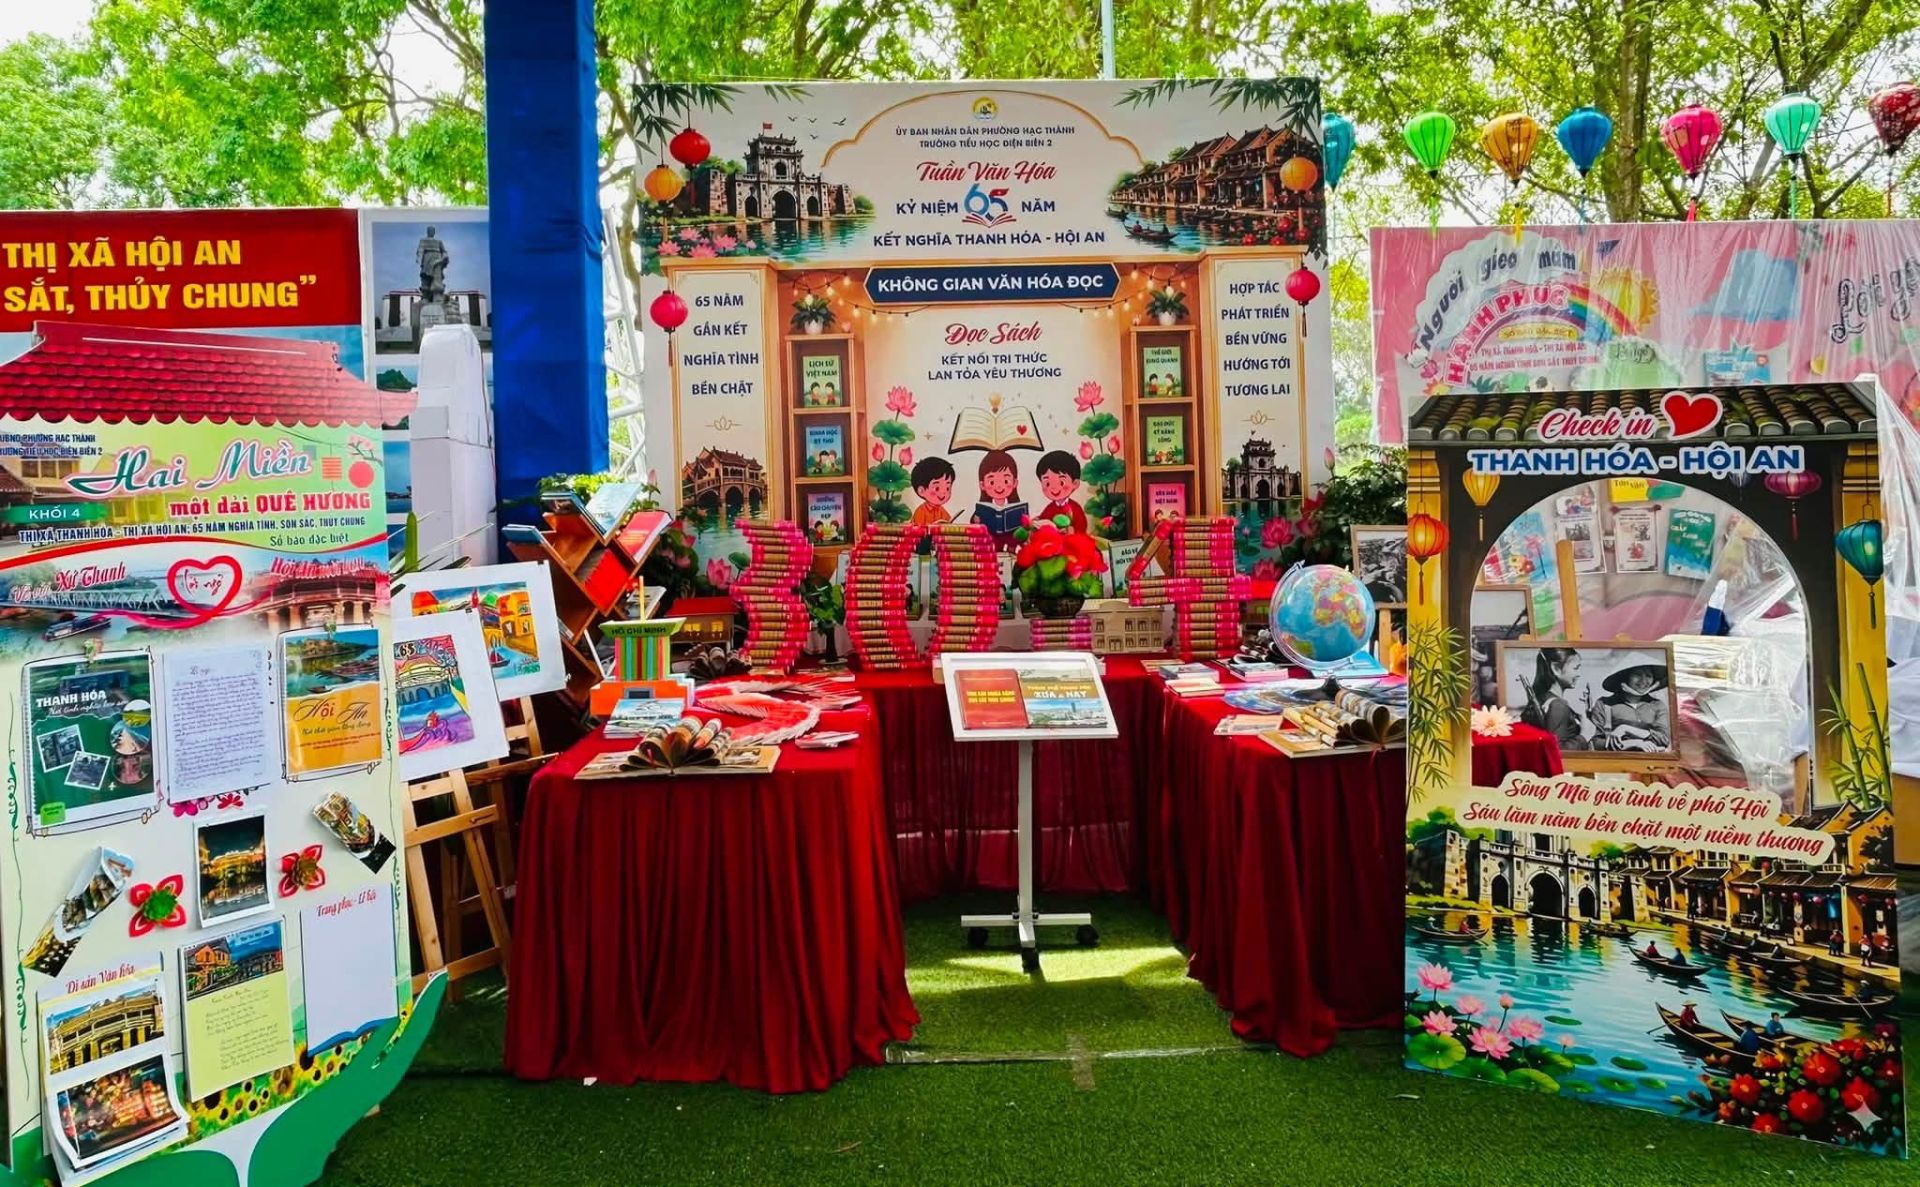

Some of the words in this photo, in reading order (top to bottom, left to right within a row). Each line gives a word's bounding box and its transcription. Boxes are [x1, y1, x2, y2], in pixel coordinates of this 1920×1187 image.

[895, 124, 909, 136] ỦY
[910, 126, 929, 136] BAN
[931, 125, 958, 136] NHÂN
[959, 125, 980, 136] DÂN
[982, 124, 1020, 135] PHƯỜNG
[1022, 126, 1043, 137] HẠC
[1045, 125, 1075, 135] THÀNH
[919, 138, 957, 149] TRƯỜNG
[958, 137, 978, 148] TIỂU
[979, 139, 999, 149] HỌC
[1046, 138, 1053, 148] 2
[916, 159, 967, 182] Tuần
[967, 161, 1011, 182] Văn
[1013, 160, 1058, 184] Hóa
[896, 197, 917, 215] KỶ
[921, 198, 959, 216] NIỆM
[963, 183, 1010, 221] 65
[1021, 197, 1056, 213] NĂM
[873, 230, 901, 247] KẾT
[905, 232, 952, 246] NGHĨA
[955, 234, 1007, 246] THANH
[1010, 231, 1042, 245] HÓA
[1055, 229, 1080, 245] HỘI
[1084, 231, 1106, 243] AN
[2, 242, 57, 274] THỊ
[68, 235, 116, 268] XÃ
[125, 235, 183, 272] HỘI
[193, 239, 242, 266] AN
[878, 274, 939, 293] KHÔNG
[942, 277, 984, 291] GIAN
[987, 275, 1022, 290] VĂN
[1026, 273, 1064, 290] HÓA
[1067, 275, 1104, 292] ĐỌC
[1228, 282, 1254, 298] HỢP
[1256, 280, 1280, 295] TÁC
[3, 276, 75, 315] SẮT,
[84, 275, 172, 311] THỦY
[694, 295, 711, 307] 65
[713, 294, 744, 307] NĂM
[1221, 306, 1254, 320] PHÁT
[1254, 303, 1290, 319] TRIỂN
[692, 323, 721, 337] GẮN
[723, 322, 748, 336] KẾT
[944, 322, 989, 347] Đọc
[990, 320, 1043, 346] Sách
[1252, 330, 1288, 345] VỮNG
[683, 352, 726, 366] NGHĨA
[727, 351, 760, 365] TÌNH
[941, 352, 965, 366] KẾT
[968, 352, 990, 365] NỐI
[992, 354, 1012, 365] TRI
[1014, 350, 1048, 364] THỨC
[1223, 357, 1270, 372] HƯỚNG
[1271, 356, 1291, 370] TỚI
[928, 370, 952, 381] LAN
[955, 367, 981, 380] TỎA
[983, 366, 1007, 380] YÊU
[1010, 366, 1062, 379] THƯƠNG
[720, 380, 754, 397] CHẶT
[1225, 383, 1270, 397] TƯƠNG
[1271, 383, 1291, 395] LAI
[1540, 410, 1621, 440] Check
[1622, 411, 1656, 437] in
[67, 447, 186, 494] Hai
[196, 437, 312, 489] Miền
[1471, 450, 1577, 472] THANH
[1586, 444, 1655, 471] HÓA
[1684, 443, 1742, 477] HỘI
[1752, 448, 1801, 470] AN
[28, 506, 67, 520] KHỐI
[71, 508, 81, 518] 4
[168, 496, 210, 520] một
[217, 494, 250, 515] dải
[255, 490, 297, 513] QUÊ
[302, 492, 371, 511] HƯƠNG
[56, 528, 93, 542] THANH
[123, 526, 138, 538] THỊ
[156, 524, 171, 537] HỘI
[192, 521, 204, 533] 65
[205, 520, 226, 533] NĂM
[228, 519, 255, 532] NGHĨA
[340, 516, 366, 527] CHUNG
[81, 560, 126, 587] Thanh
[399, 641, 415, 656] 65
[35, 692, 78, 708] THANH
[81, 689, 107, 701] HÓA
[293, 697, 337, 722] Hội
[1504, 777, 1550, 800] Sông
[1555, 780, 1589, 804] Mã
[1626, 787, 1663, 809] tình
[1667, 790, 1690, 811] về
[1688, 791, 1725, 817] phố
[1724, 795, 1770, 821] Hội
[1463, 801, 1502, 822] Sáu
[1504, 805, 1537, 825] lăm
[1540, 811, 1580, 830] năm
[1584, 808, 1616, 834] bền
[1621, 815, 1661, 841] chặt
[1664, 823, 1701, 848] một
[1703, 821, 1751, 847] niềm
[1756, 829, 1825, 857] thương
